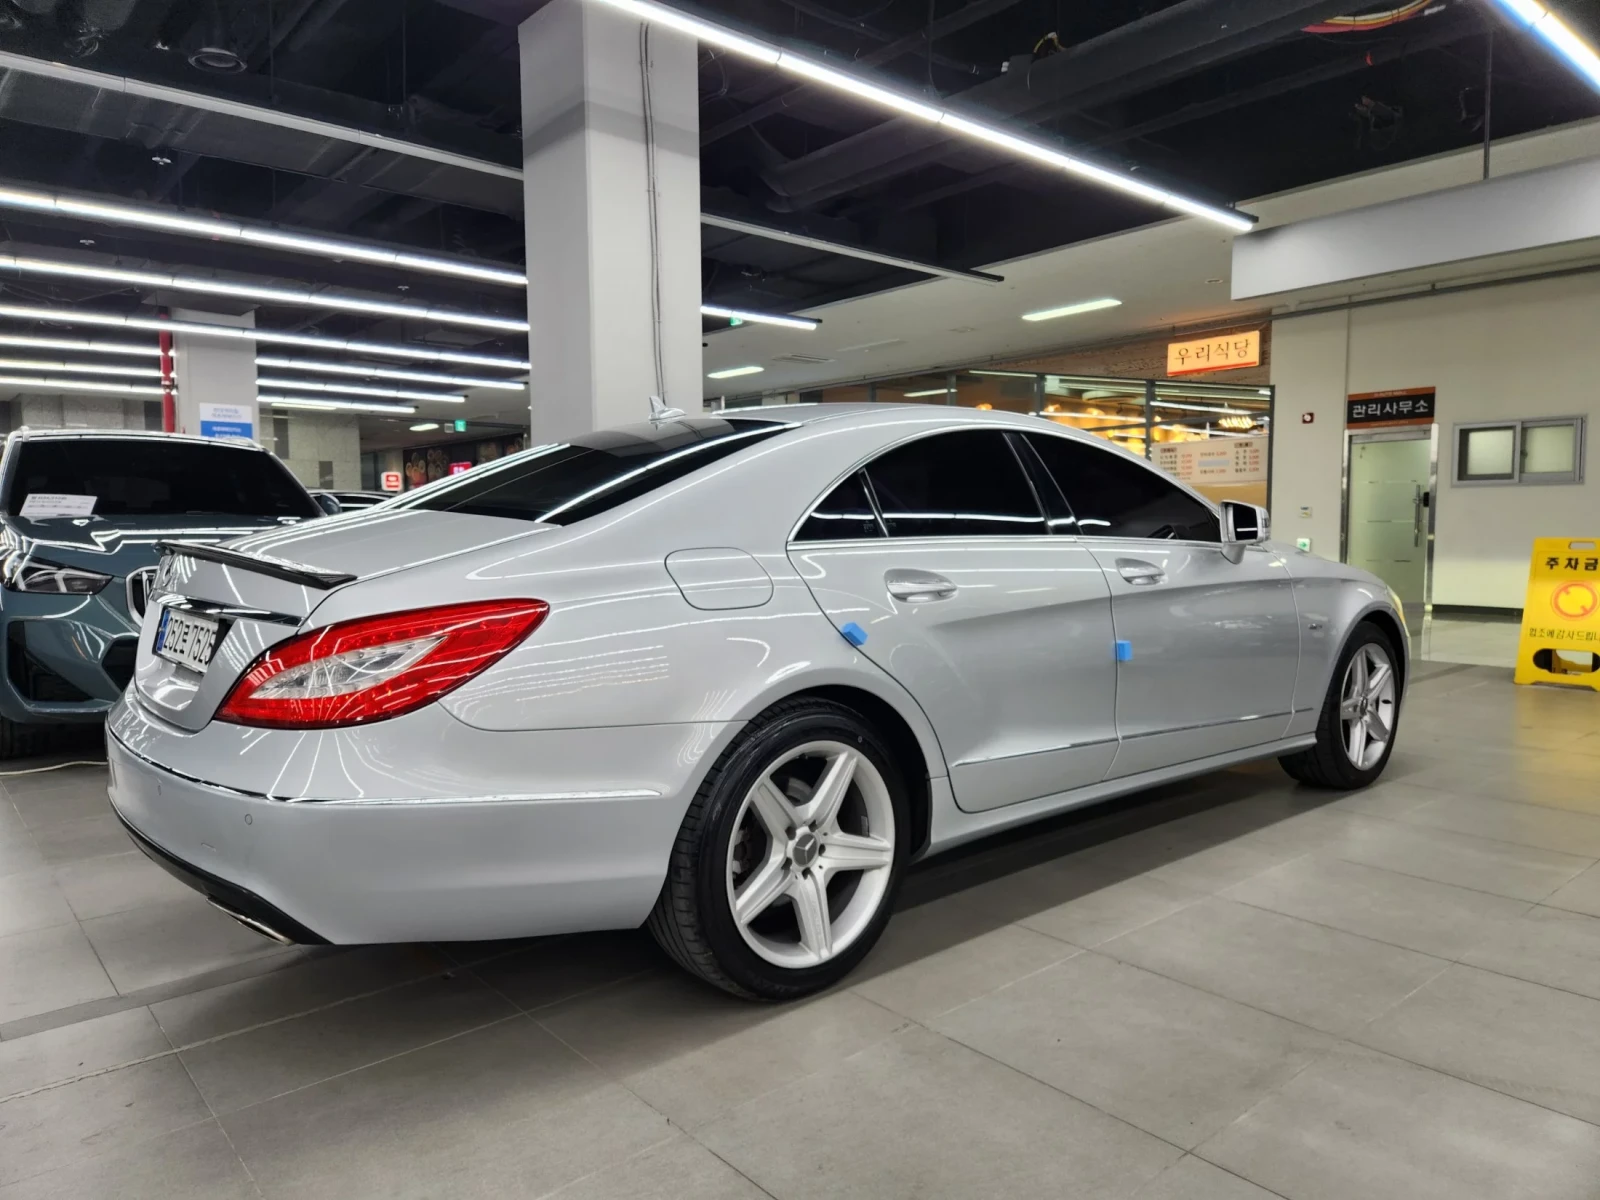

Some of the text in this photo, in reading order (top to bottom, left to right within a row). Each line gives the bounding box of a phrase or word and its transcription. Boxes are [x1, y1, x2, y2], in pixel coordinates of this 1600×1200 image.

[1174, 339, 1251, 365] 우리식당
[1352, 400, 1429, 418] 관리사무소
[1545, 556, 1599, 571] 주차금
[187, 625, 217, 666] 7525
